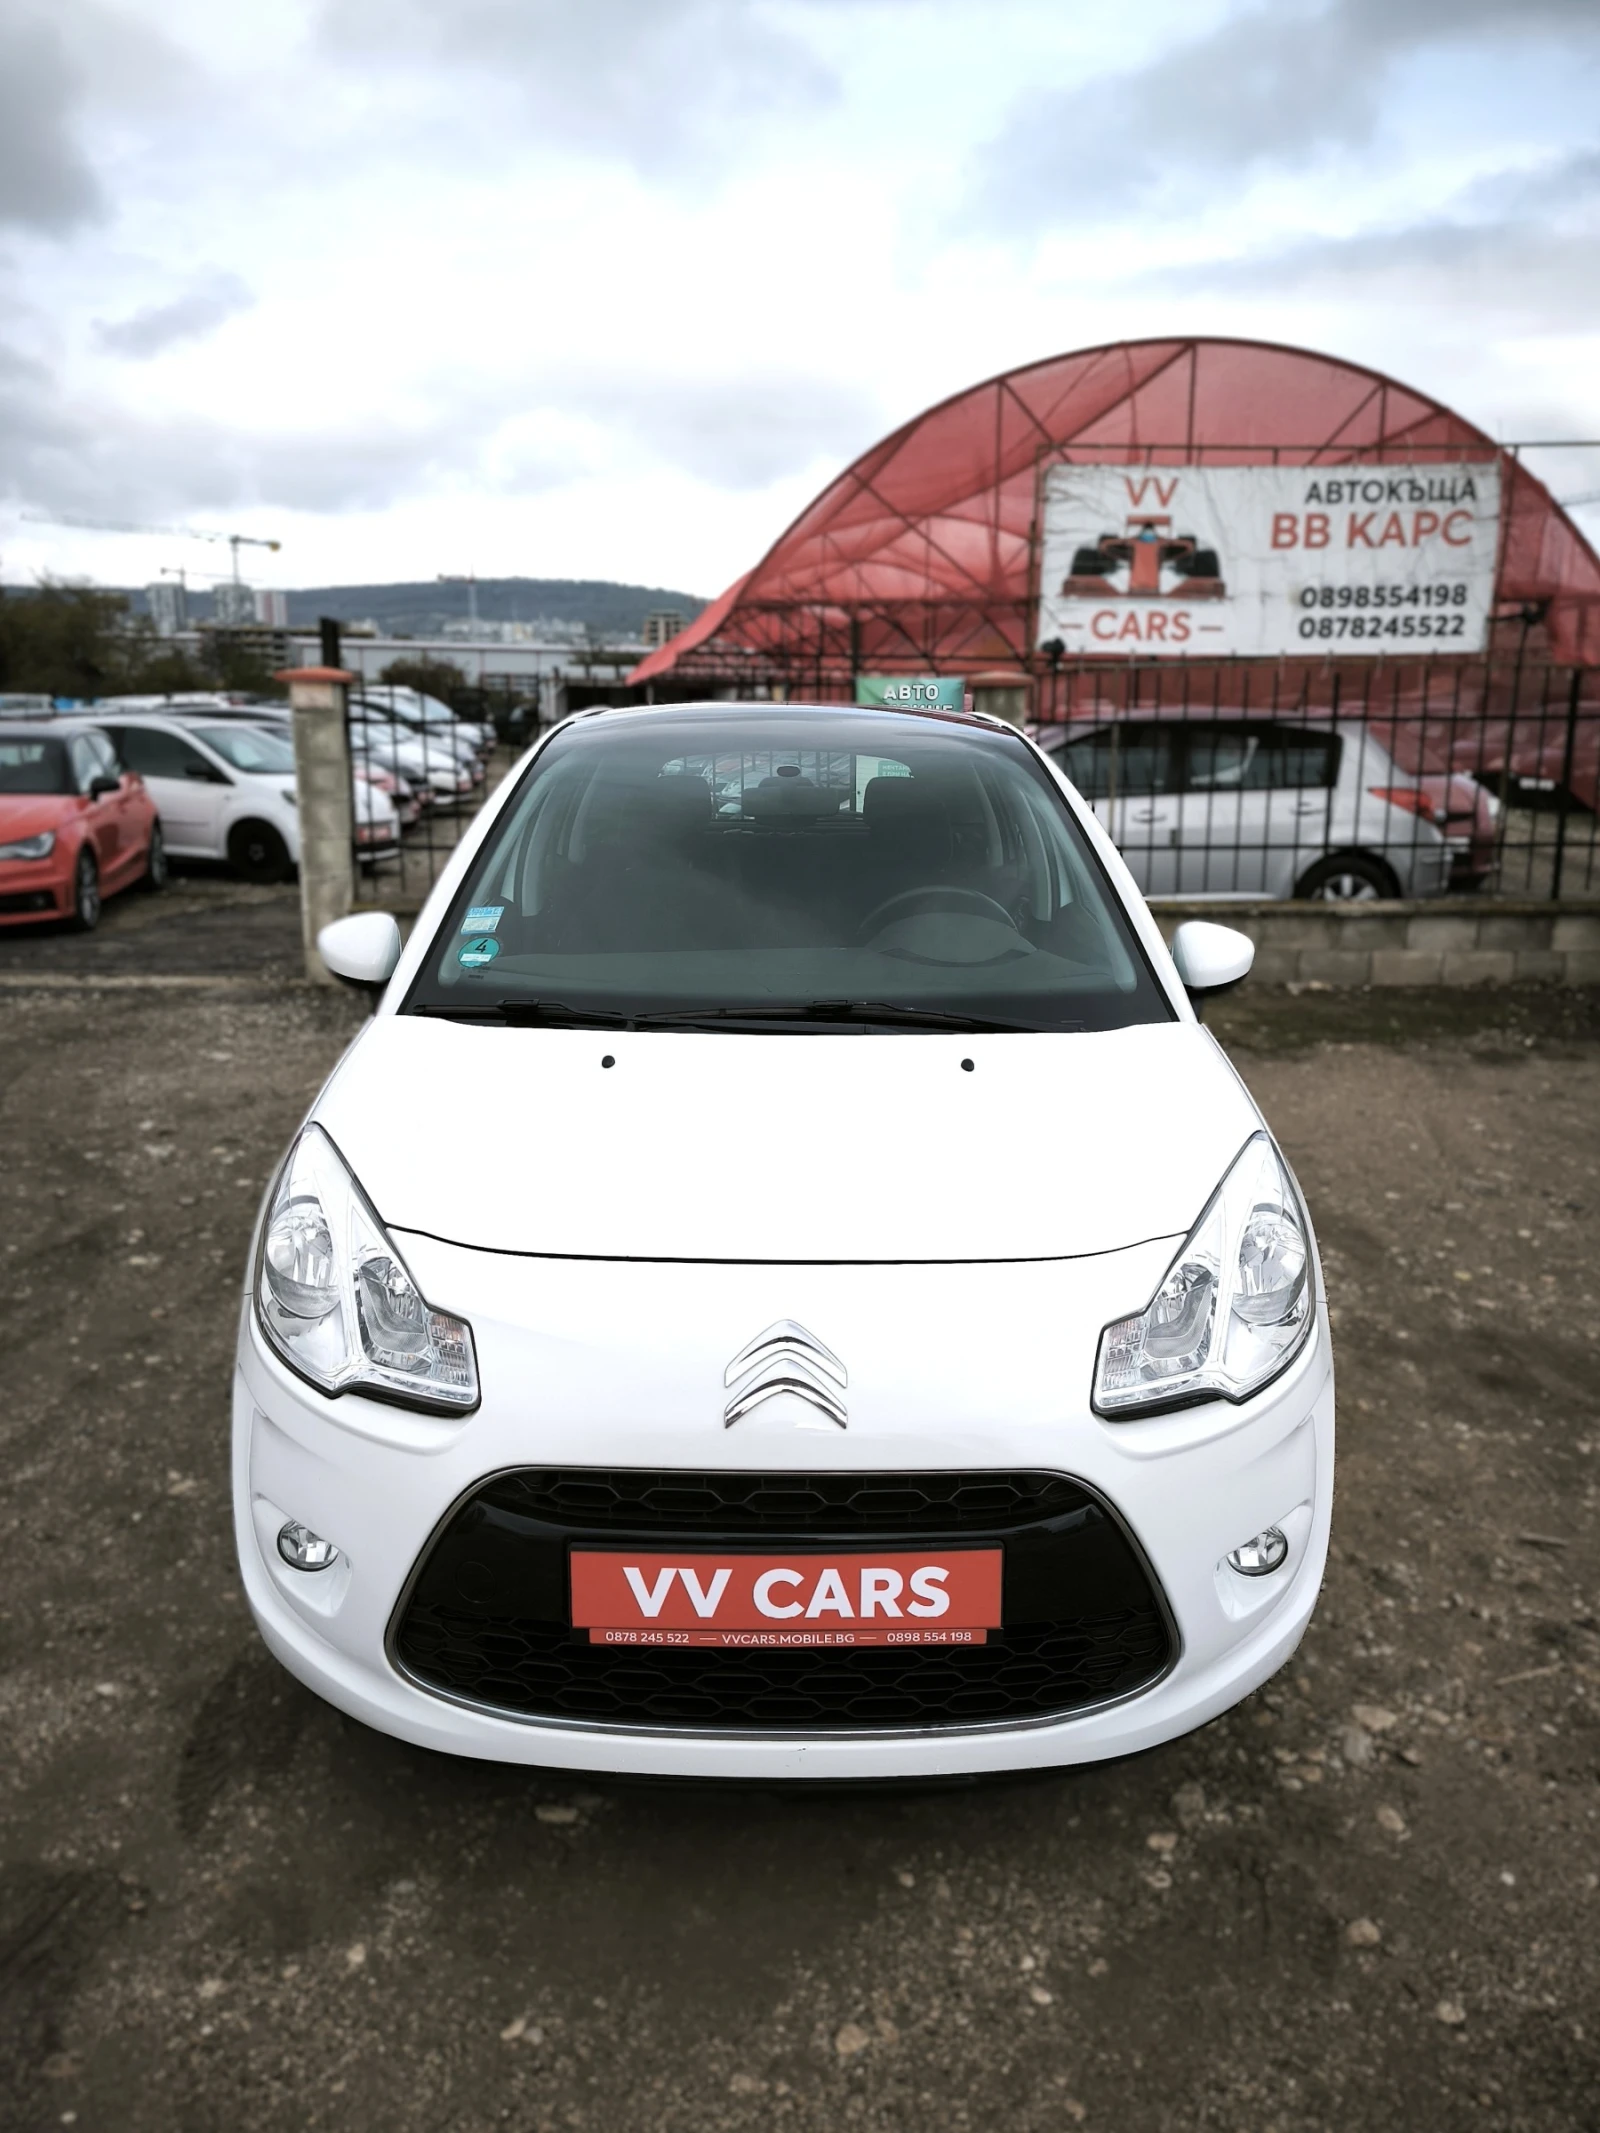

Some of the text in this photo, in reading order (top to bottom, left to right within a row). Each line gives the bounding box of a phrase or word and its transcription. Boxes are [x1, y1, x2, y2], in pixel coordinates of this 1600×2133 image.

[1124, 477, 1180, 508] VV
[1305, 477, 1477, 505] АВТОКЪЩА
[1271, 509, 1474, 550] ВВ КАРС
[1300, 584, 1468, 609] 0898554198
[1090, 611, 1192, 642] CARS
[1299, 614, 1466, 639] 0878245522
[883, 684, 940, 700] АВТО
[474, 939, 489, 953] 4
[622, 1566, 951, 1619] VV CARS
[605, 1631, 972, 1645] 0878 245 522 VVCARS.MOBILE.BG 0898 554 198
